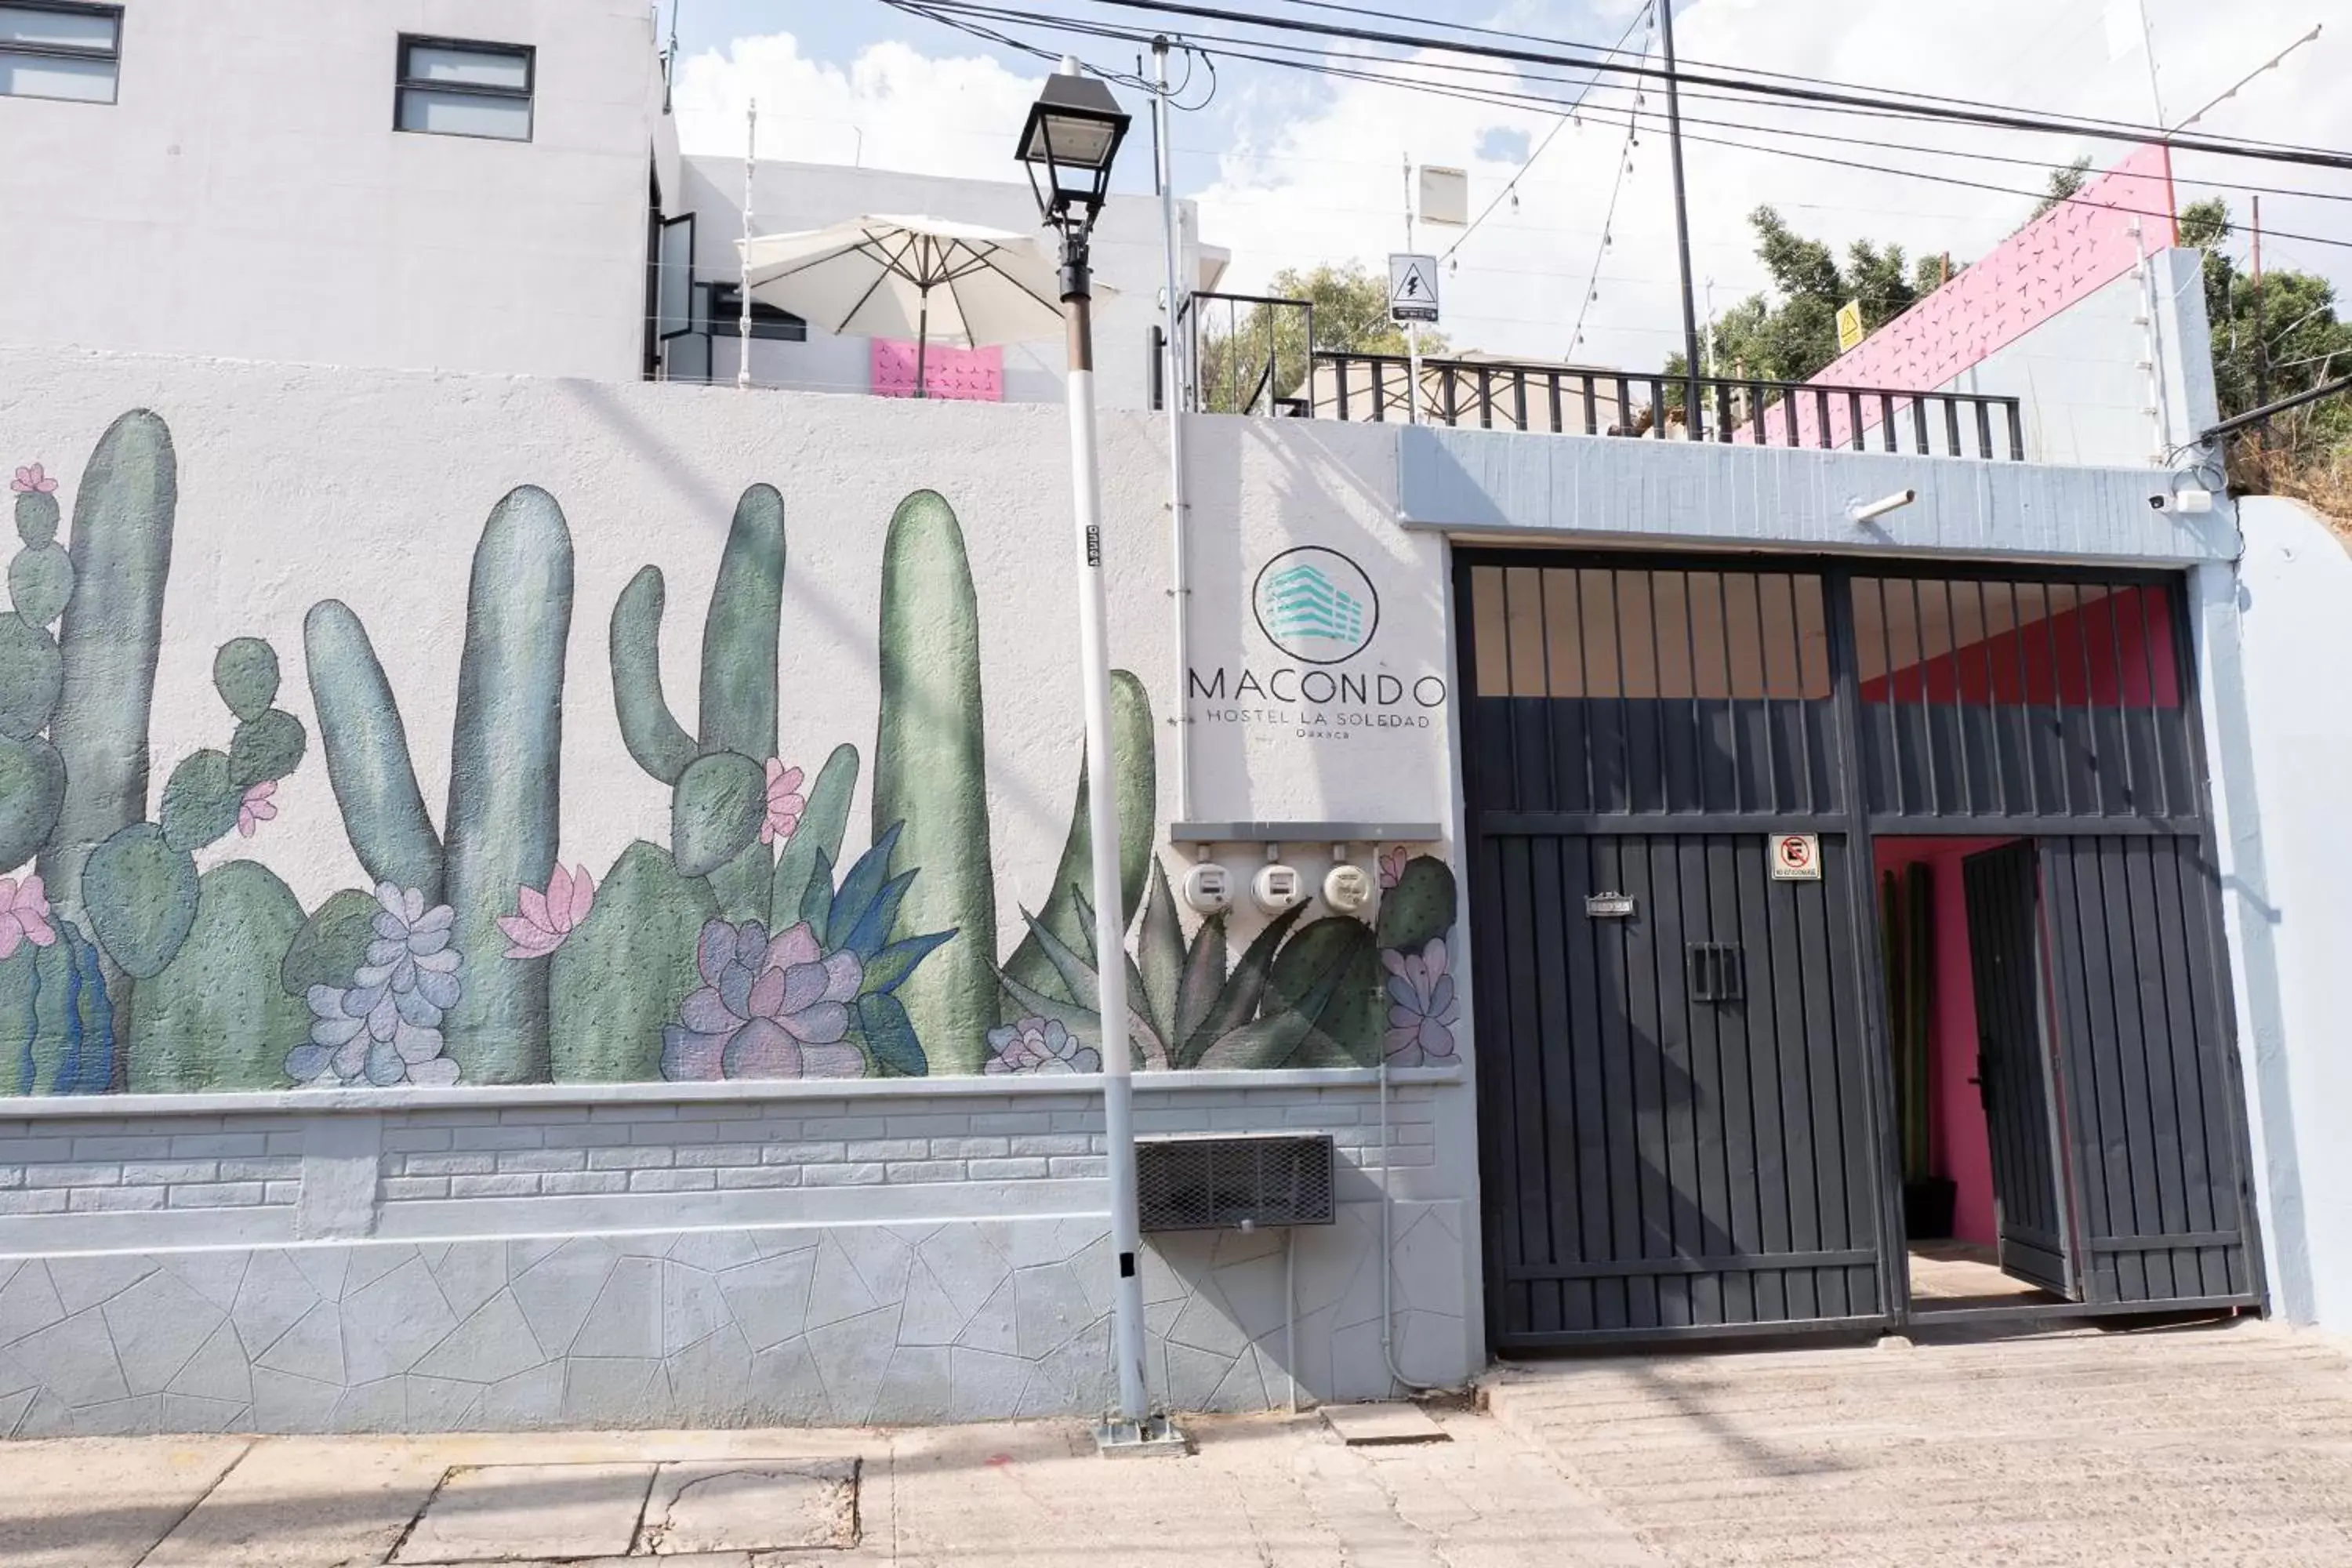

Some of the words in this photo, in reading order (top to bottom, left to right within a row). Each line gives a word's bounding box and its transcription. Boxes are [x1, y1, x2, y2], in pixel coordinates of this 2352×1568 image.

[1189, 667, 1446, 707] MACONDO
[1207, 709, 1289, 723] HOSTEL
[1300, 710, 1327, 725] LA
[1336, 712, 1430, 728] SOLEDAD
[1296, 728, 1350, 739] Oaxaca
